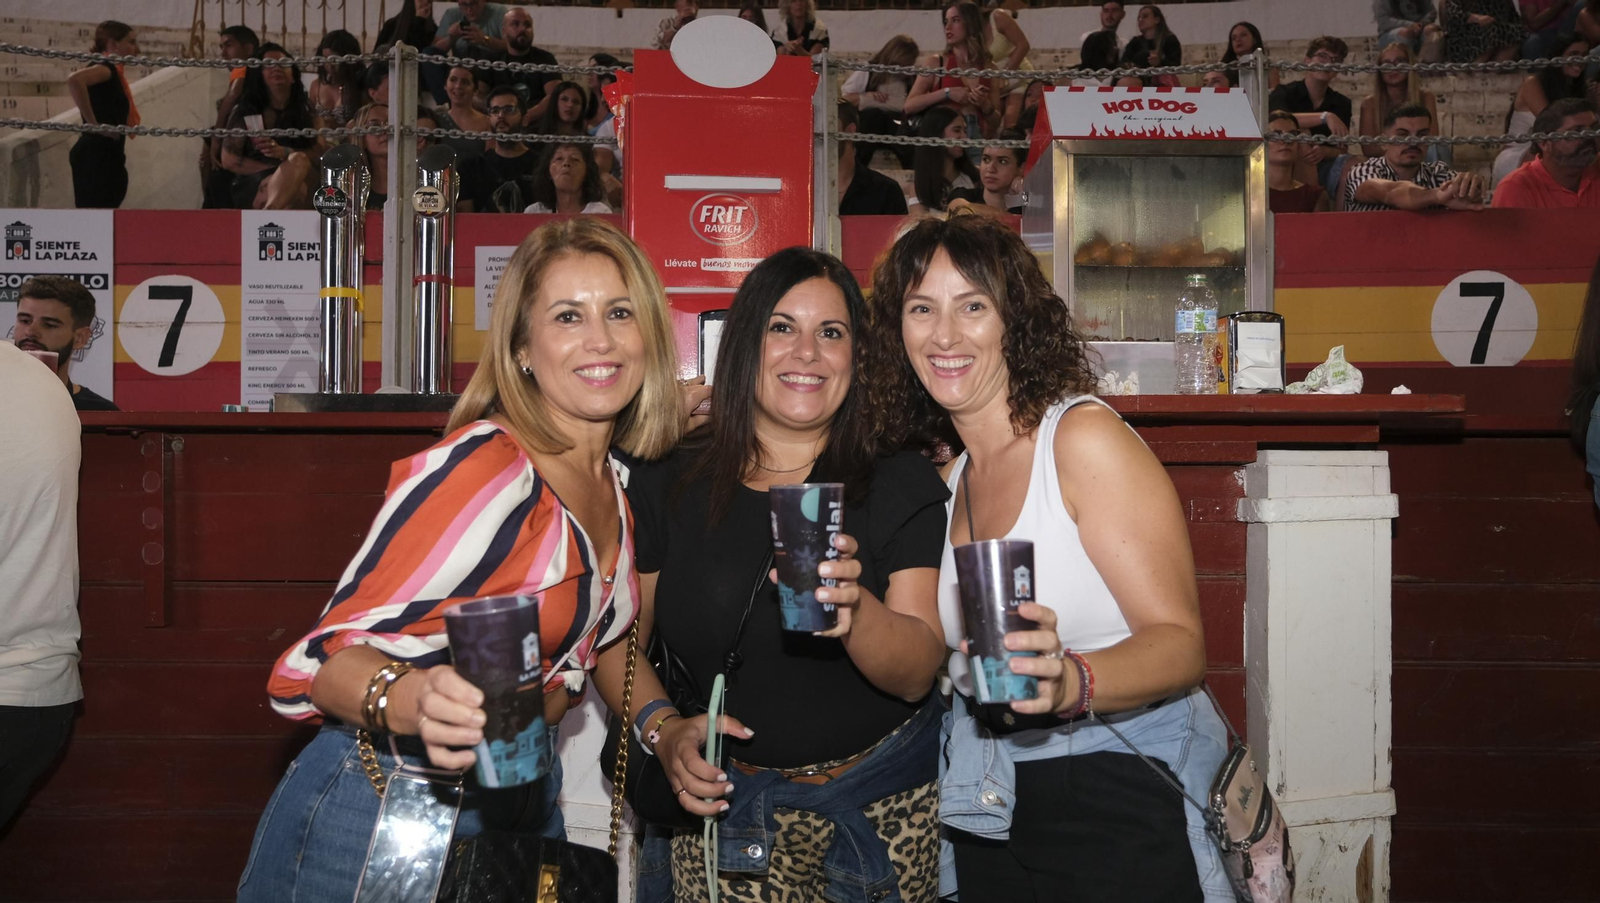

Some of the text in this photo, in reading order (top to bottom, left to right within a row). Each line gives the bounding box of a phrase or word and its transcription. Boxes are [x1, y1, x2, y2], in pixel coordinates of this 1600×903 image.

[1102, 98, 1198, 114] HOT DOG
[700, 205, 748, 224] FRIT
[704, 224, 741, 233] RAVICH
[35, 241, 81, 250] SIENTE
[287, 242, 321, 251] SIENT
[35, 252, 98, 260] LA PLAZA
[287, 252, 320, 261] LA PL
[664, 258, 698, 268] Llévate
[148, 285, 193, 367] 7
[1460, 282, 1505, 364] 7
[820, 501, 842, 612] sétela!
